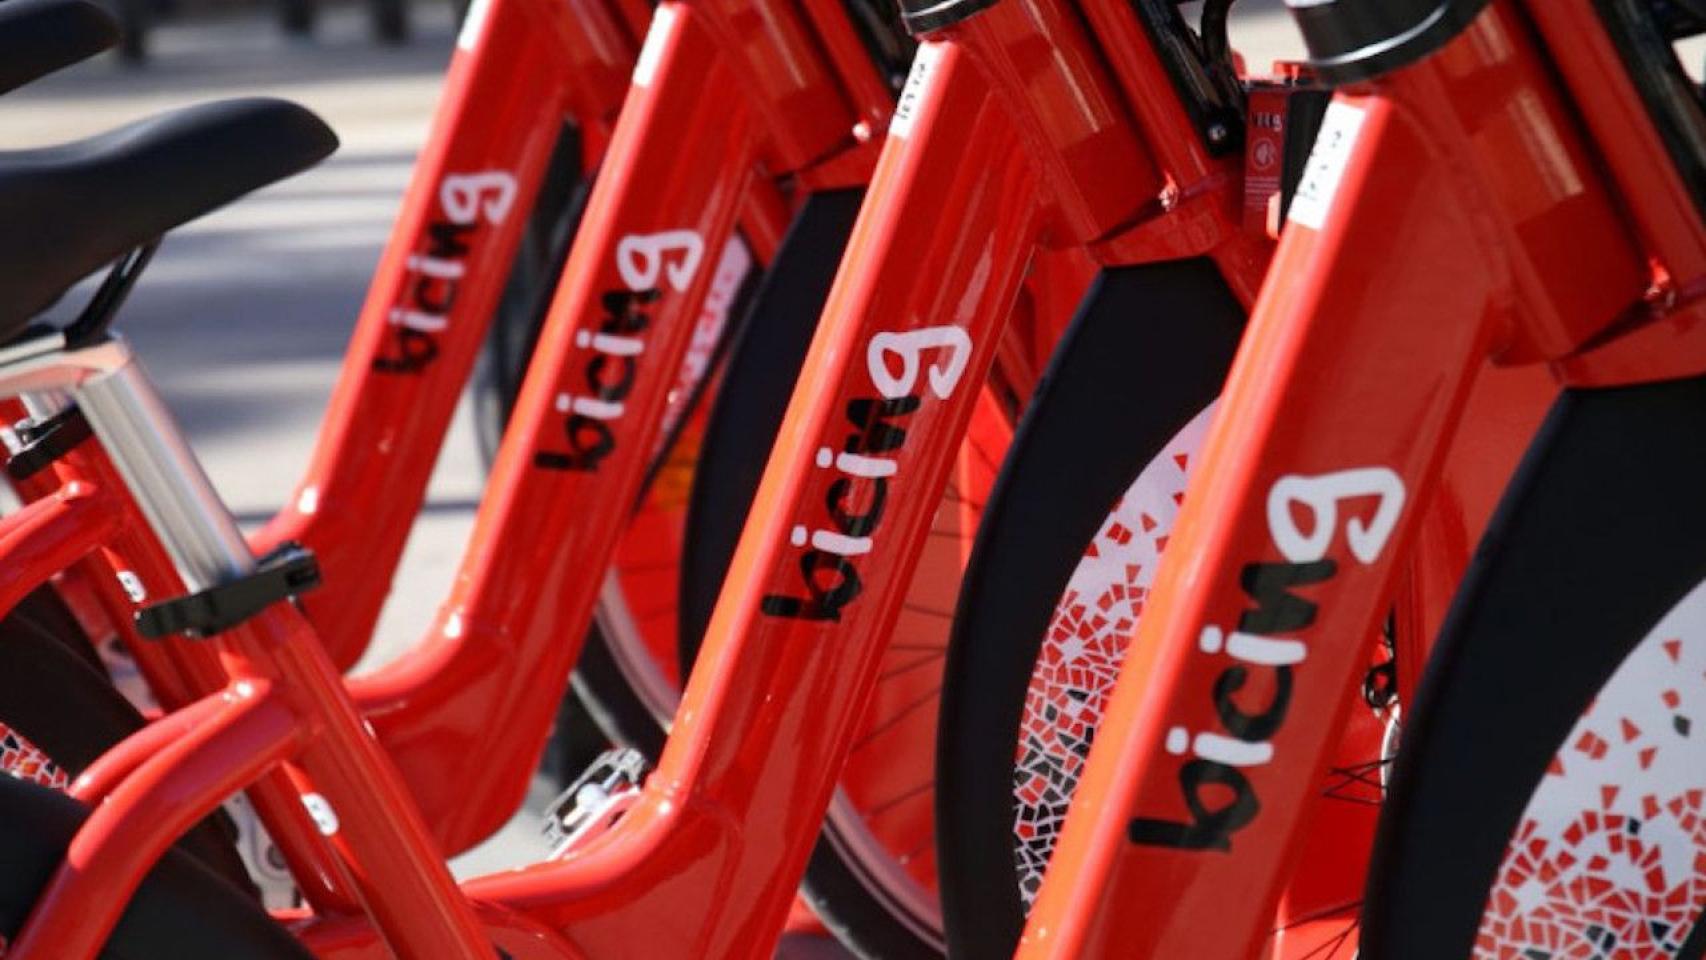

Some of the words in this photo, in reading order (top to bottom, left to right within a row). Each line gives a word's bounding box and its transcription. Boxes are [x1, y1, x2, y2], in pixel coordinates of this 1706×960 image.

[371, 171, 519, 375] bicing
[533, 229, 705, 471] bicing
[761, 326, 973, 622] bicing
[1128, 466, 1406, 853] bicing
